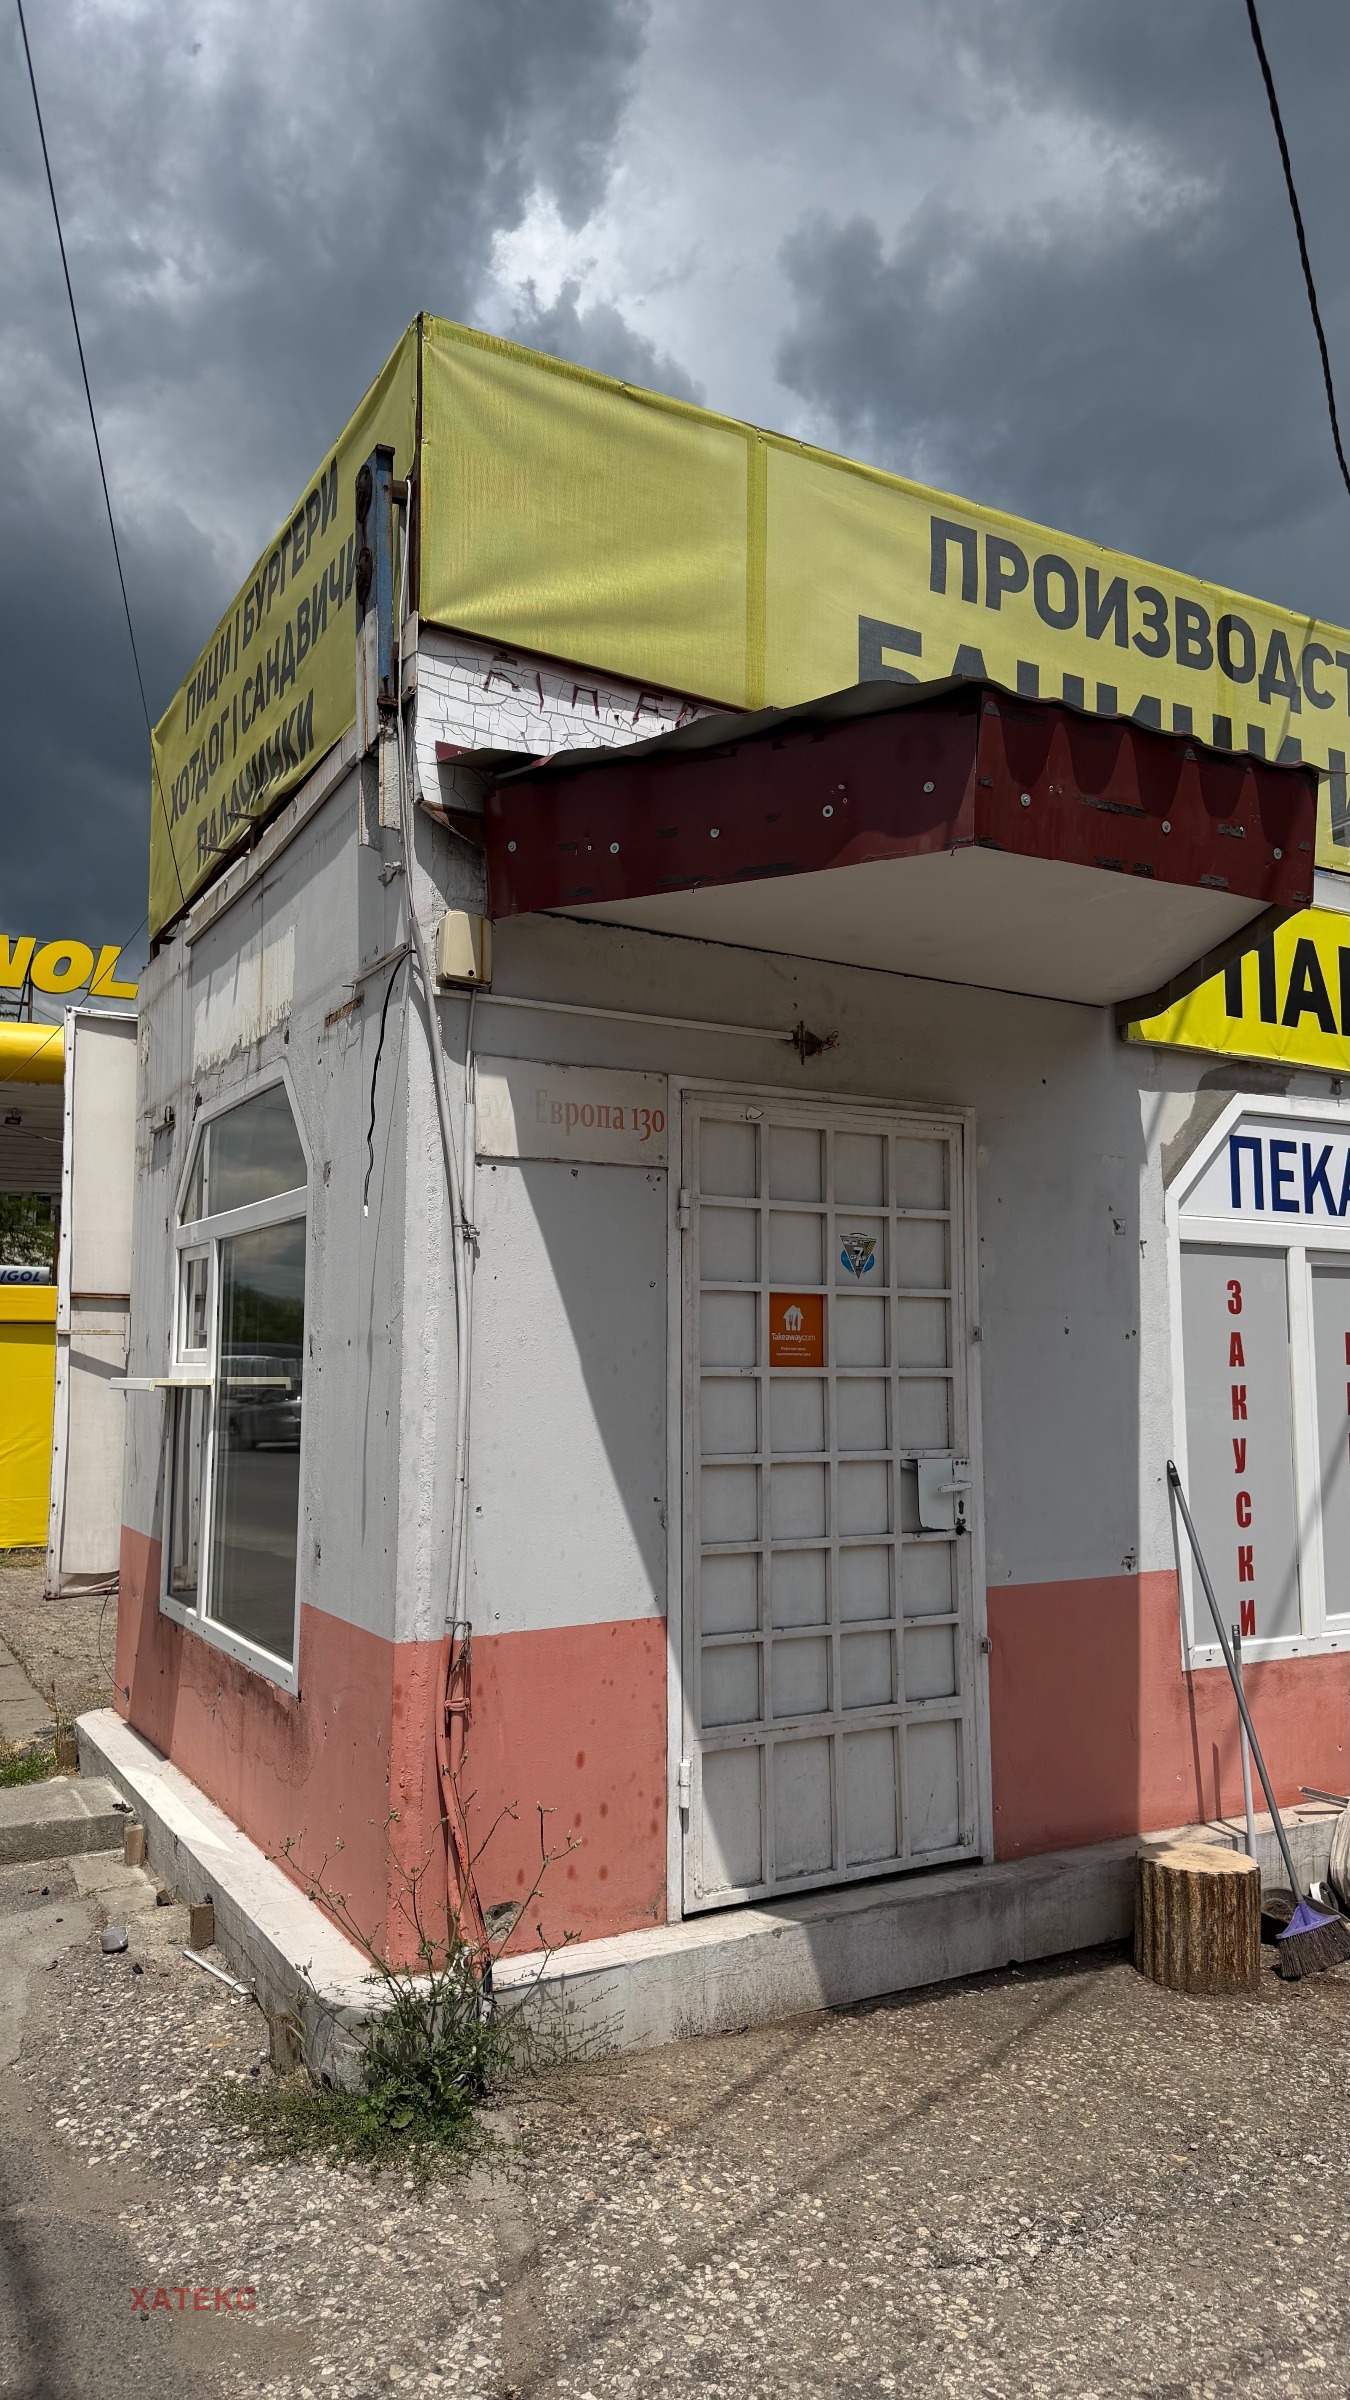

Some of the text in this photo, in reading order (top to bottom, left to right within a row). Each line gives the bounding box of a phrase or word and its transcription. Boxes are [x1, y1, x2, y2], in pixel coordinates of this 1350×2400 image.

[185, 622, 232, 735] ПИЦИ
[243, 455, 338, 651] БУРГЕРИ
[169, 705, 229, 831] ХОТДОГ
[535, 1088, 625, 1136] Европа
[631, 1107, 665, 1141] 130
[1226, 1279, 1256, 1636] ЗАКУСКИ
